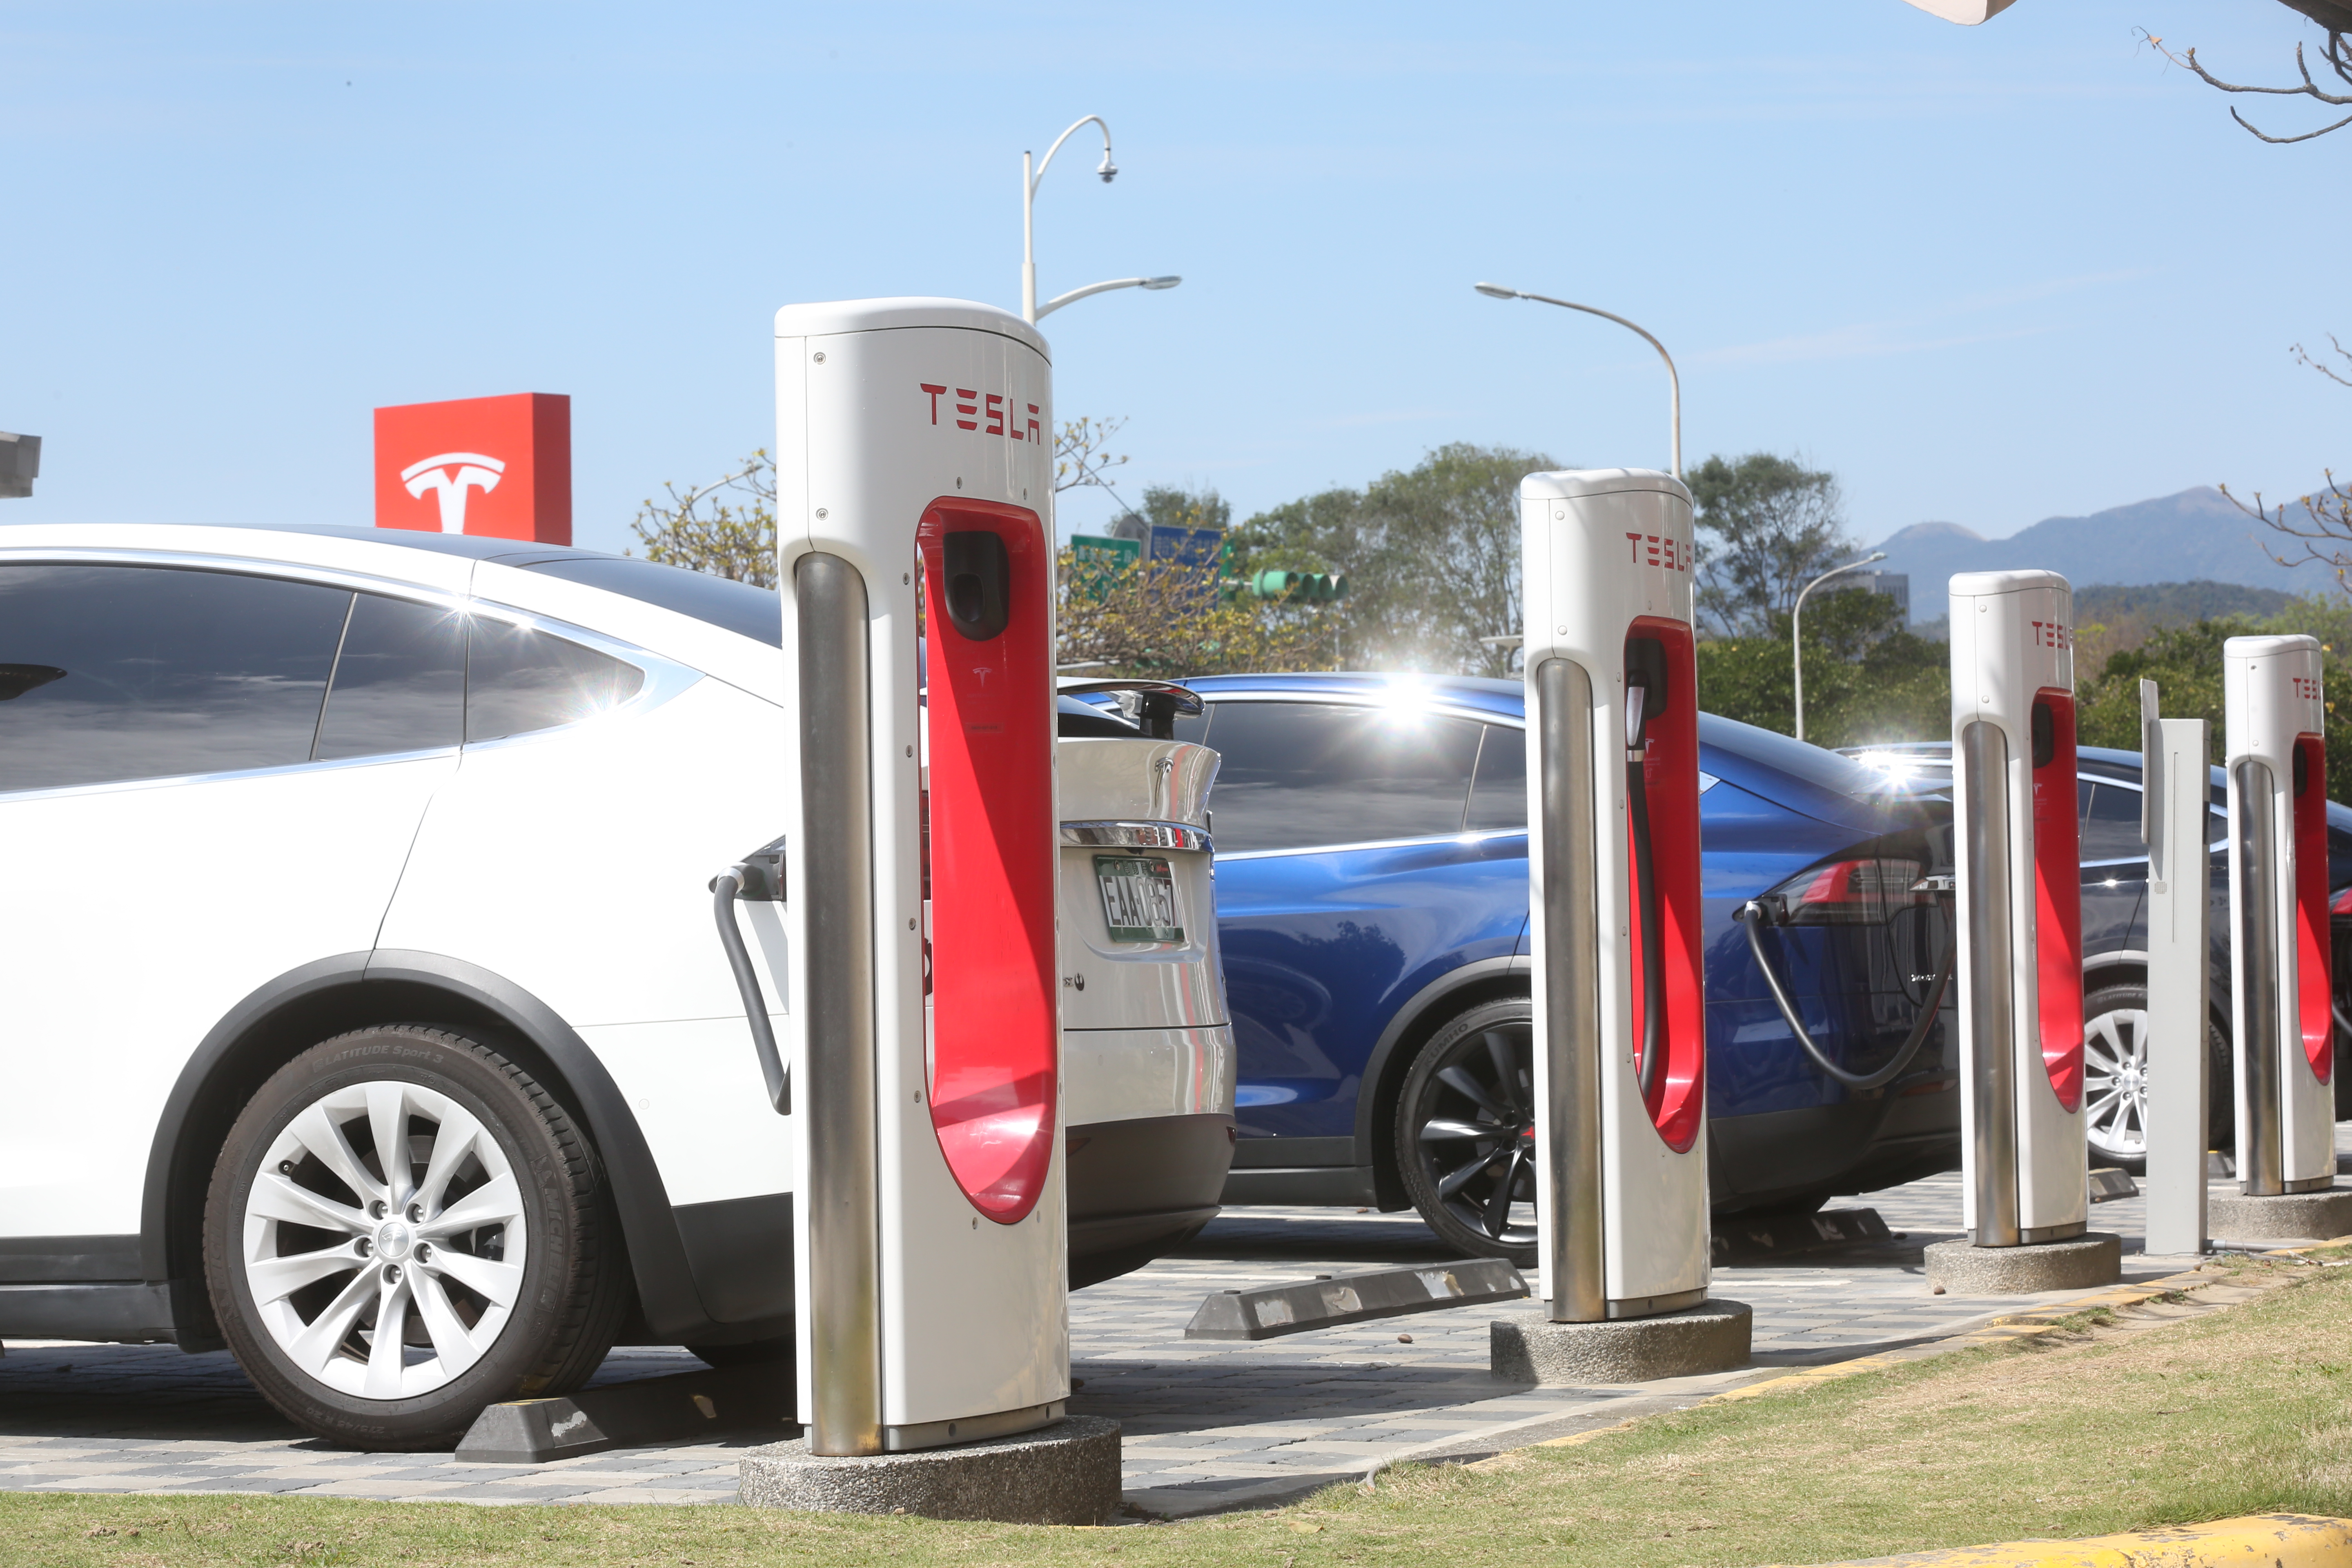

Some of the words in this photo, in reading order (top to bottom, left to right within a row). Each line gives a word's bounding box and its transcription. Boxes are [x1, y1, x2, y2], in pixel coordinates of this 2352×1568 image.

[920, 383, 1040, 445] TESLA
[1626, 532, 1692, 574] TESLA
[2292, 677, 2322, 701] TESL
[1102, 876, 1176, 926] EAA-0857
[325, 1045, 390, 1066] LATITUDE
[392, 1045, 431, 1060] Sport
[432, 1054, 444, 1064] 3
[1424, 1023, 1469, 1068] KUMHO
[540, 1187, 564, 1310] MICHELIN
